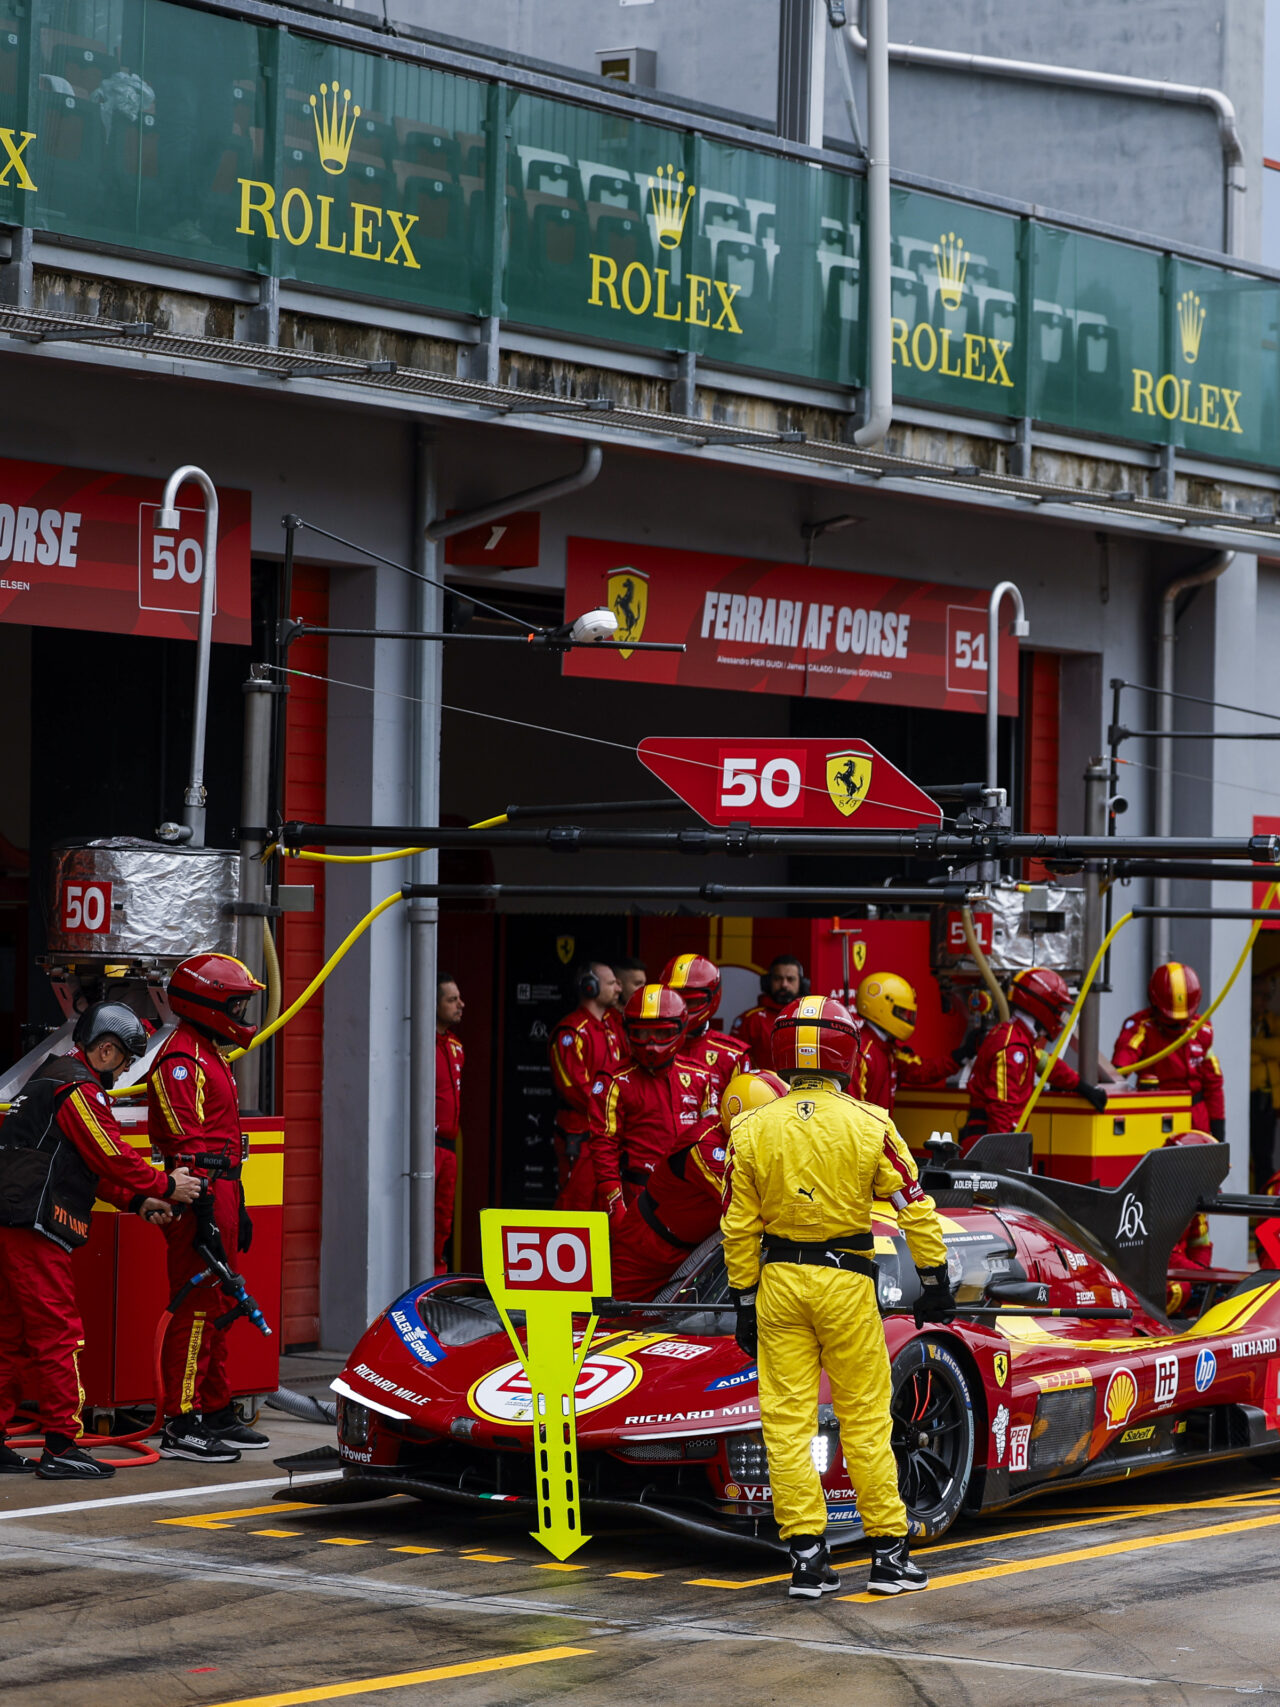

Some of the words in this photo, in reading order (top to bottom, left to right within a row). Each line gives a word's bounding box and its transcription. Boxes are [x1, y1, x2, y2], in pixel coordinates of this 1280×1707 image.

[236, 178, 421, 269] ROLEX
[587, 254, 743, 335] ROLEX
[891, 318, 1014, 388] ROLEX
[1132, 368, 1243, 434] ROLEX
[153, 535, 203, 584] 50
[0, 580, 30, 591] ELSEN
[701, 591, 803, 648] FERRARI
[802, 603, 834, 650] AF
[835, 606, 911, 659] CORSE
[750, 658, 765, 667] PIER
[766, 659, 783, 669] GUIDI
[808, 664, 834, 674] CALADO
[955, 630, 988, 671] 51
[720, 757, 801, 808] 50
[66, 886, 105, 930] 50
[951, 922, 988, 945] 51
[172, 1065, 188, 1080] hp
[712, 1147, 726, 1162] hp
[954, 1180, 973, 1190] ADLER
[979, 1180, 998, 1190] GROUP
[54, 1204, 67, 1226] PIT
[506, 1231, 587, 1283] 50
[391, 1311, 413, 1334] ADLER
[411, 1340, 438, 1363] GROUP
[1231, 1337, 1277, 1359] RICHARD
[353, 1363, 398, 1392] RICHARD
[394, 1387, 432, 1406] MILLE
[716, 1371, 758, 1388] ADLE
[942, 1352, 971, 1403] MICHELIN
[1042, 1371, 1086, 1389] DHL
[1195, 1349, 1216, 1392] hp
[624, 1410, 715, 1425] RICHARD
[722, 1405, 760, 1416] MIL
[1125, 1429, 1151, 1442] Sabelt
[744, 1487, 773, 1500] V-P
